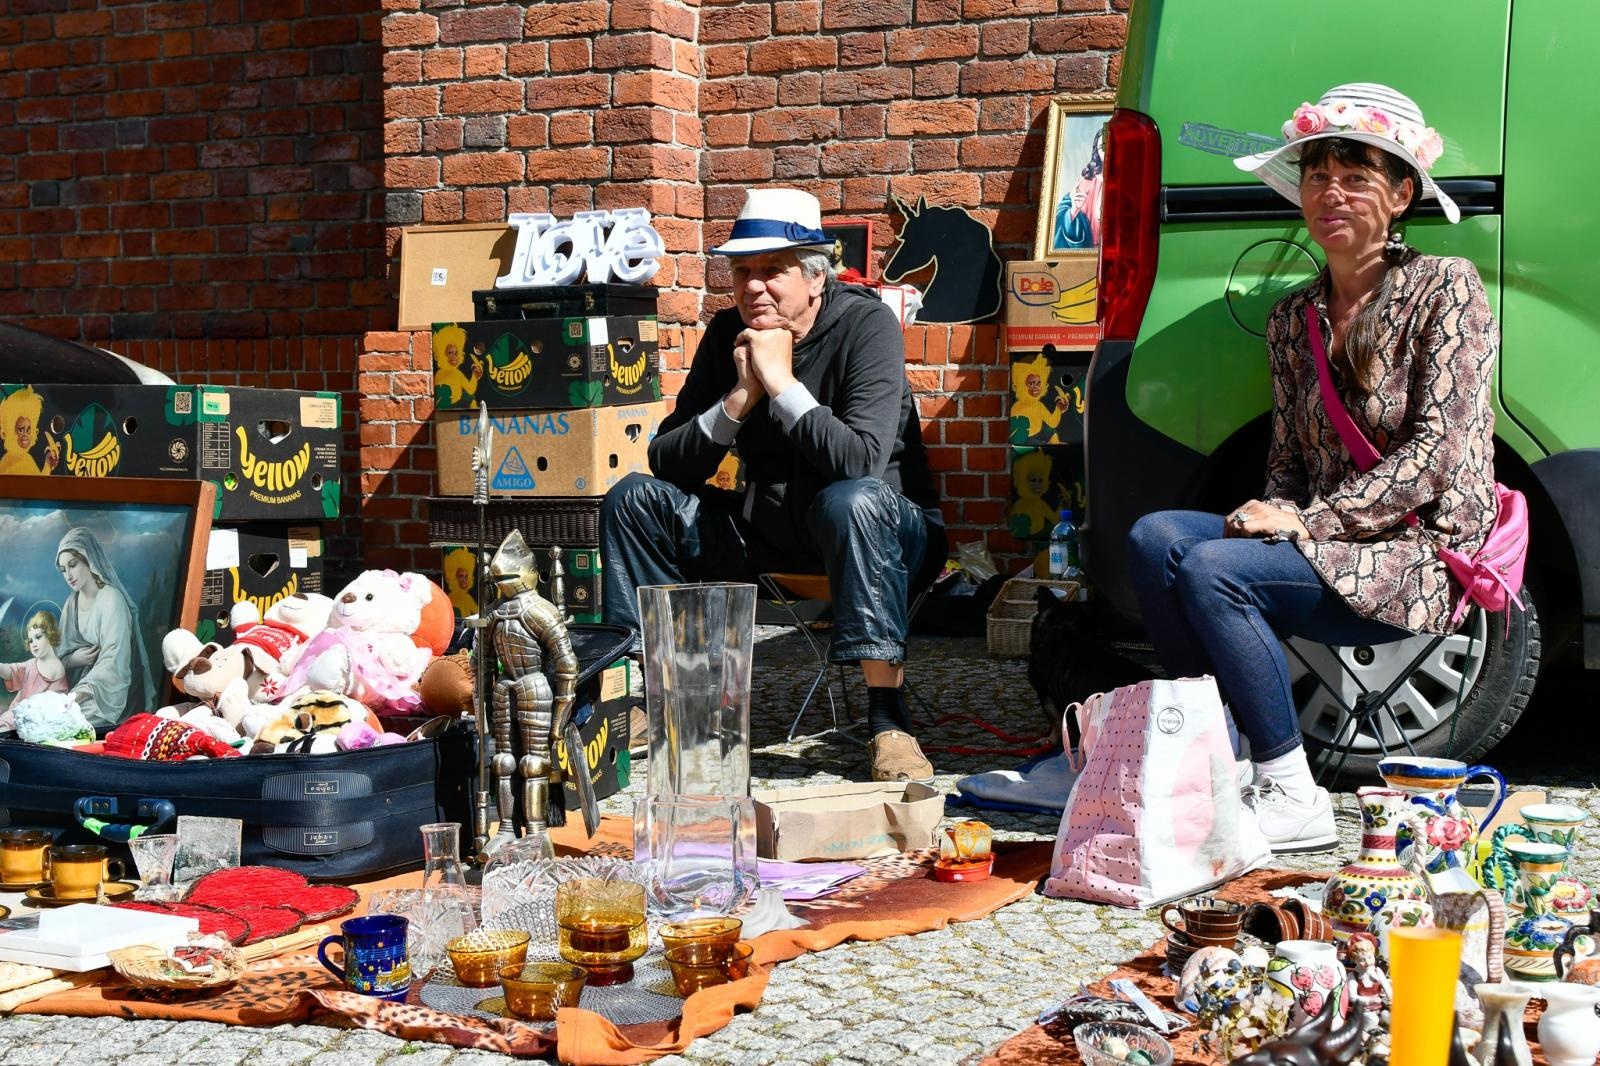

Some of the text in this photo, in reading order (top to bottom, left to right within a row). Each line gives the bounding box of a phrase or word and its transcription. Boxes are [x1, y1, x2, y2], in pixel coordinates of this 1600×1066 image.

[486, 353, 532, 385] yellow
[607, 343, 646, 386] yellow
[235, 425, 310, 491] yellow
[249, 489, 302, 504] PREMIUM BANANAS
[495, 479, 531, 488] AMIGO
